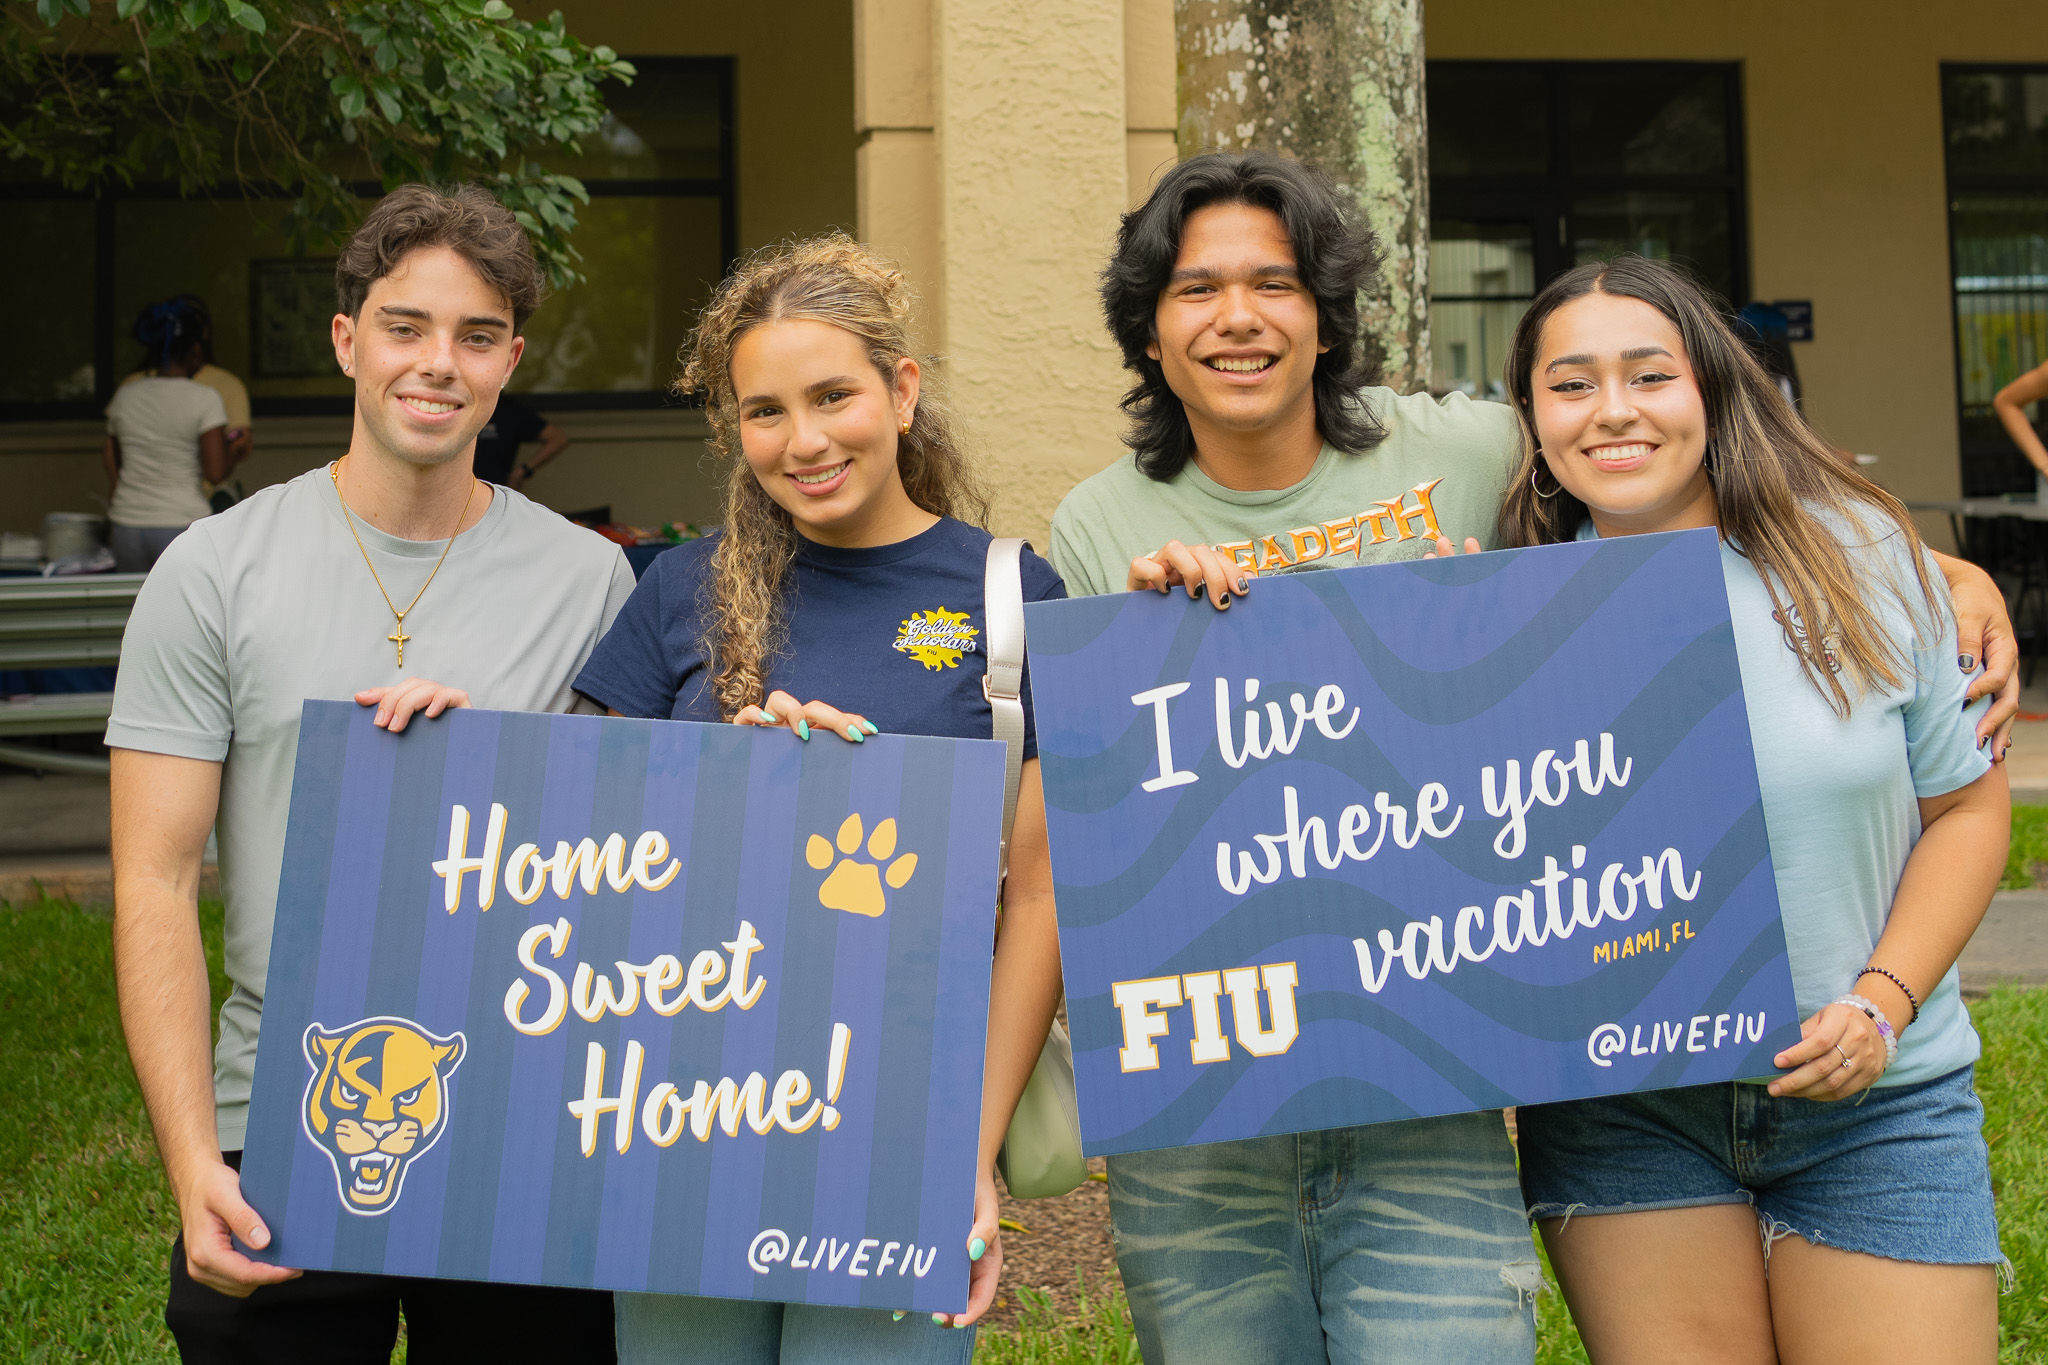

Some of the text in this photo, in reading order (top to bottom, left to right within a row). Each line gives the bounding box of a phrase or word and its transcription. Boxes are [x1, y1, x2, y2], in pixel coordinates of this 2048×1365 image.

[1143, 477, 1455, 579] GADETH
[892, 633, 977, 652] Scholars
[907, 618, 973, 638] Golden
[1130, 676, 1360, 792] I live
[432, 803, 681, 914] Home
[1216, 732, 1632, 895] where you
[1352, 844, 1702, 993] vacation
[504, 917, 766, 1035] Sweet
[1111, 961, 1299, 1073] FIU
[567, 1023, 851, 1157] Home!
[1587, 1011, 1766, 1067] @LIVEFIU
[748, 1228, 937, 1278] @LIVEFIU
